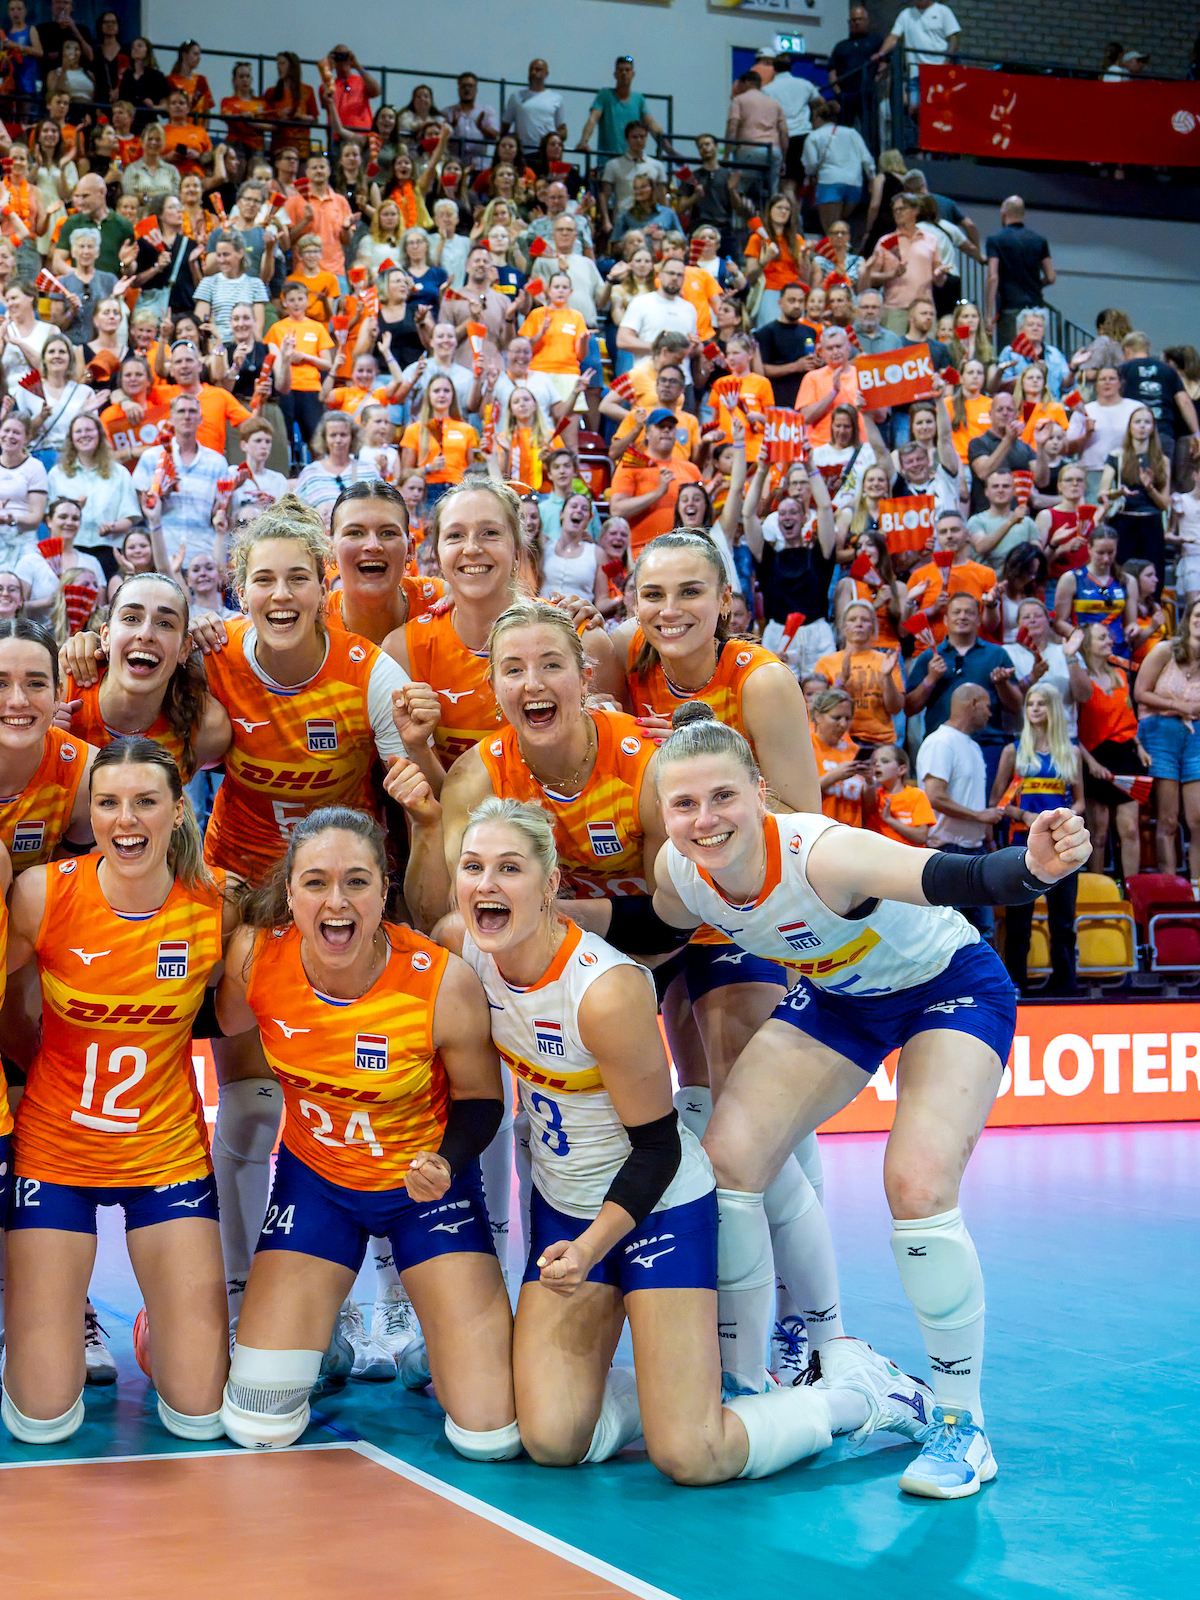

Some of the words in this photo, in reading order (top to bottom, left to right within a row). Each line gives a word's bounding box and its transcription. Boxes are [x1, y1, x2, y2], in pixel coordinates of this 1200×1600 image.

[857, 356, 934, 390] BLOCK
[309, 738, 337, 750] NED
[238, 760, 340, 790] DHL
[13, 839, 41, 851] NED
[594, 841, 622, 856] NED
[789, 936, 822, 951] NED
[157, 963, 186, 977] NED
[64, 997, 184, 1025] DHL
[356, 1055, 387, 1069] NED
[537, 1039, 566, 1056] NED
[80, 1042, 148, 1119] 12
[272, 1066, 392, 1104] DHL
[299, 1099, 385, 1157] 24
[531, 1091, 570, 1158] 3
[14, 1176, 41, 1208] 12
[261, 1204, 296, 1235] 24
